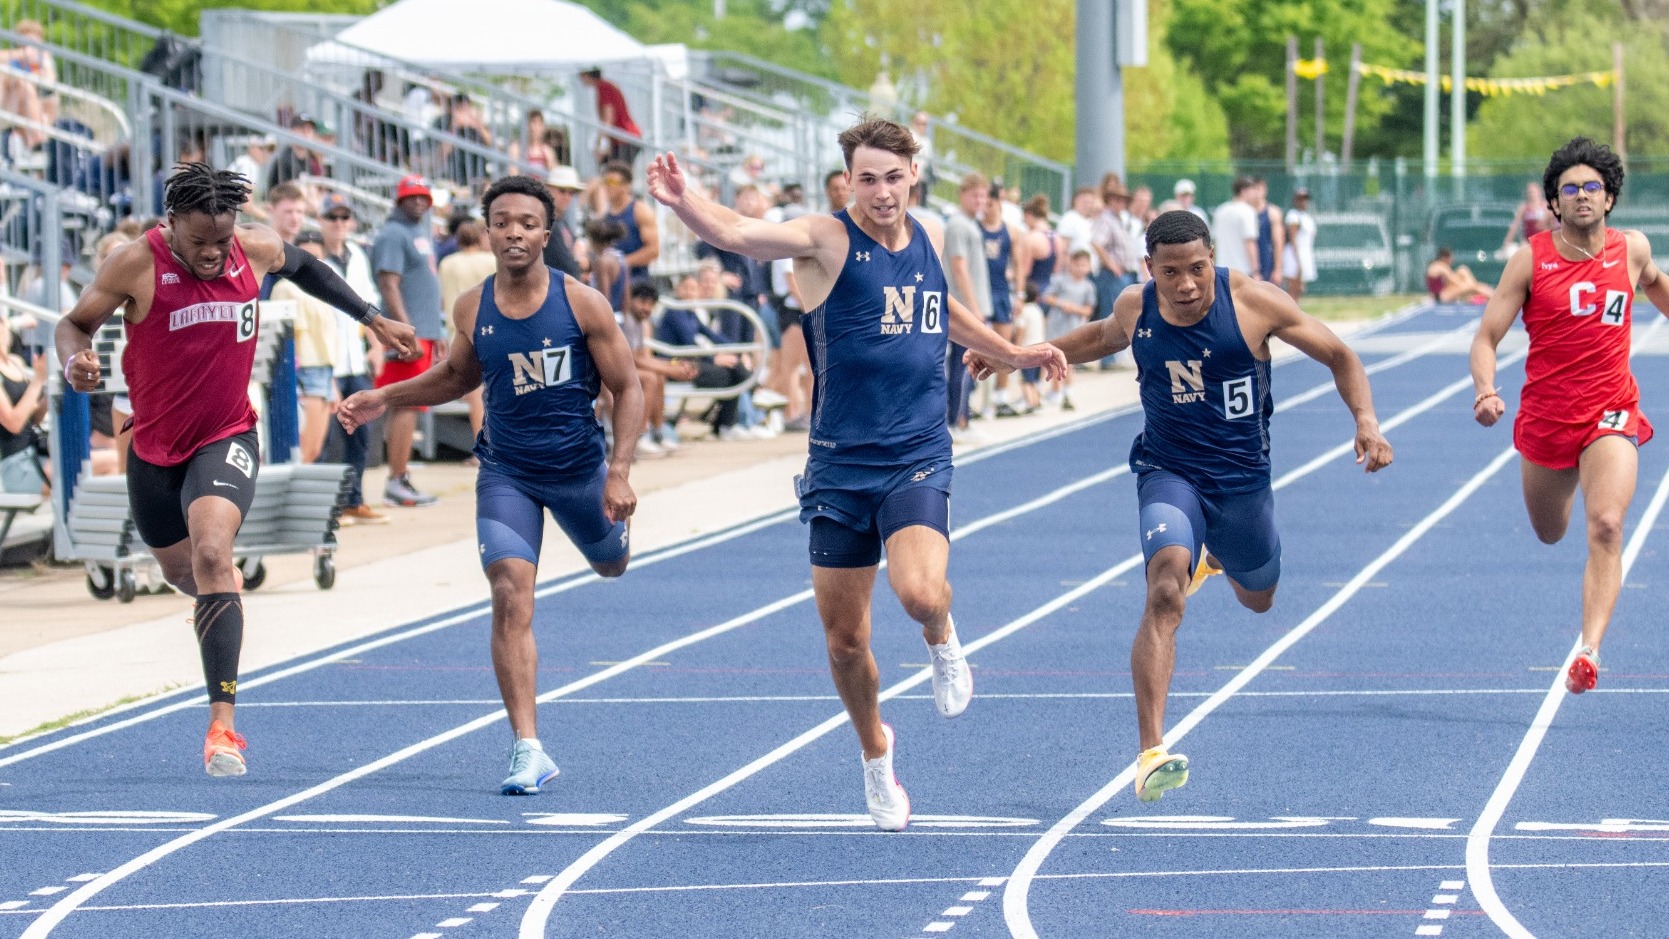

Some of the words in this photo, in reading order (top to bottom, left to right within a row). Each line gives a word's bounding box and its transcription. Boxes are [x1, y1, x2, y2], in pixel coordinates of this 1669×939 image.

[881, 286, 916, 323] N
[925, 294, 938, 331] 6
[1569, 281, 1597, 317] C
[1606, 294, 1625, 323] 4
[172, 305, 237, 327] LAFAYET
[241, 303, 254, 337] 8
[881, 323, 913, 335] NAVY
[508, 350, 545, 386] N
[546, 350, 566, 382] 7
[1165, 359, 1205, 392] N
[514, 383, 545, 396] NAVY
[1172, 391, 1206, 404] NAVY
[1228, 381, 1249, 415] 5
[1602, 411, 1622, 428] 4
[231, 447, 250, 471] 8
